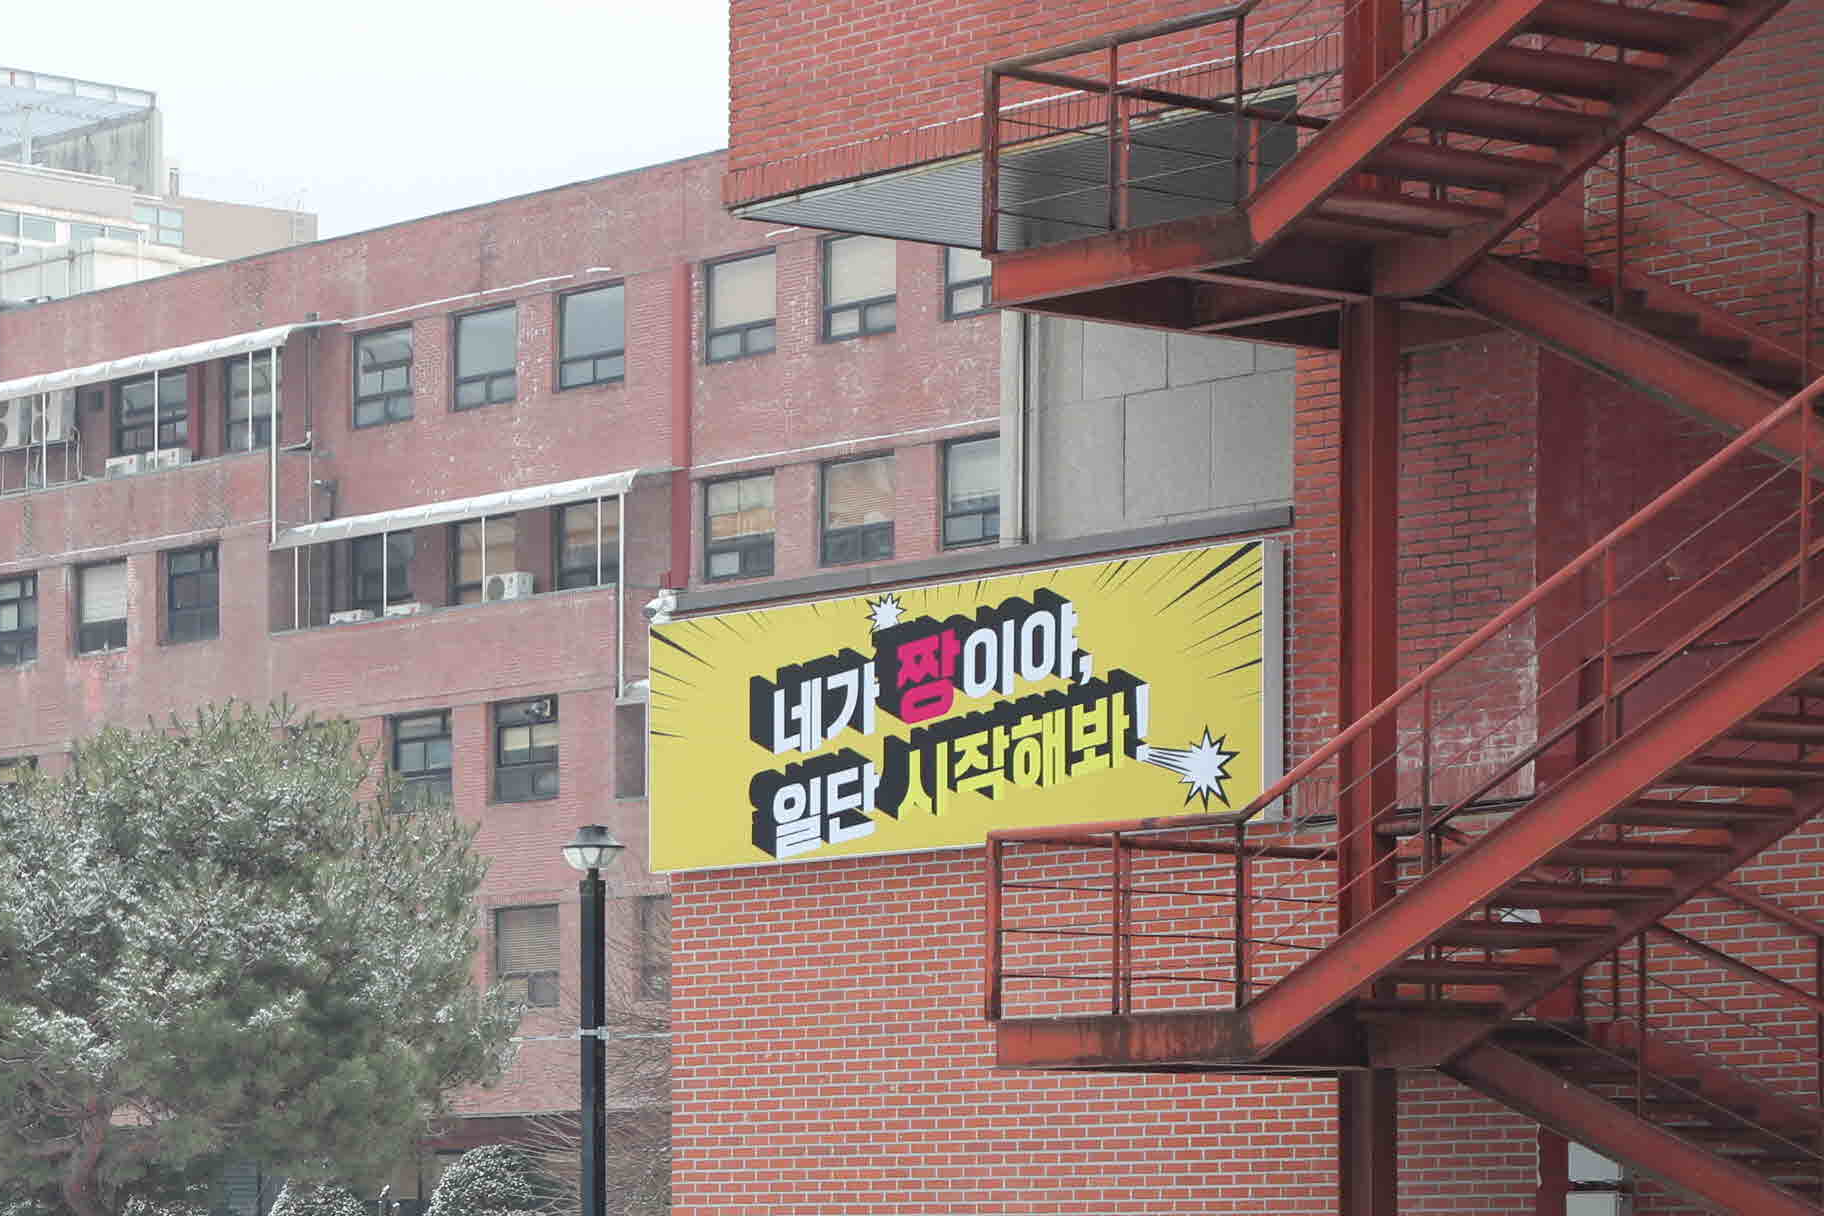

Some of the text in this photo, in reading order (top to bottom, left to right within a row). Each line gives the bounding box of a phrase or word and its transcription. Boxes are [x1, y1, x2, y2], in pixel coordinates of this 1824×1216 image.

[773, 601, 1094, 755] 네가 짱이야,
[772, 683, 1151, 859] 일단 시작해봐!
